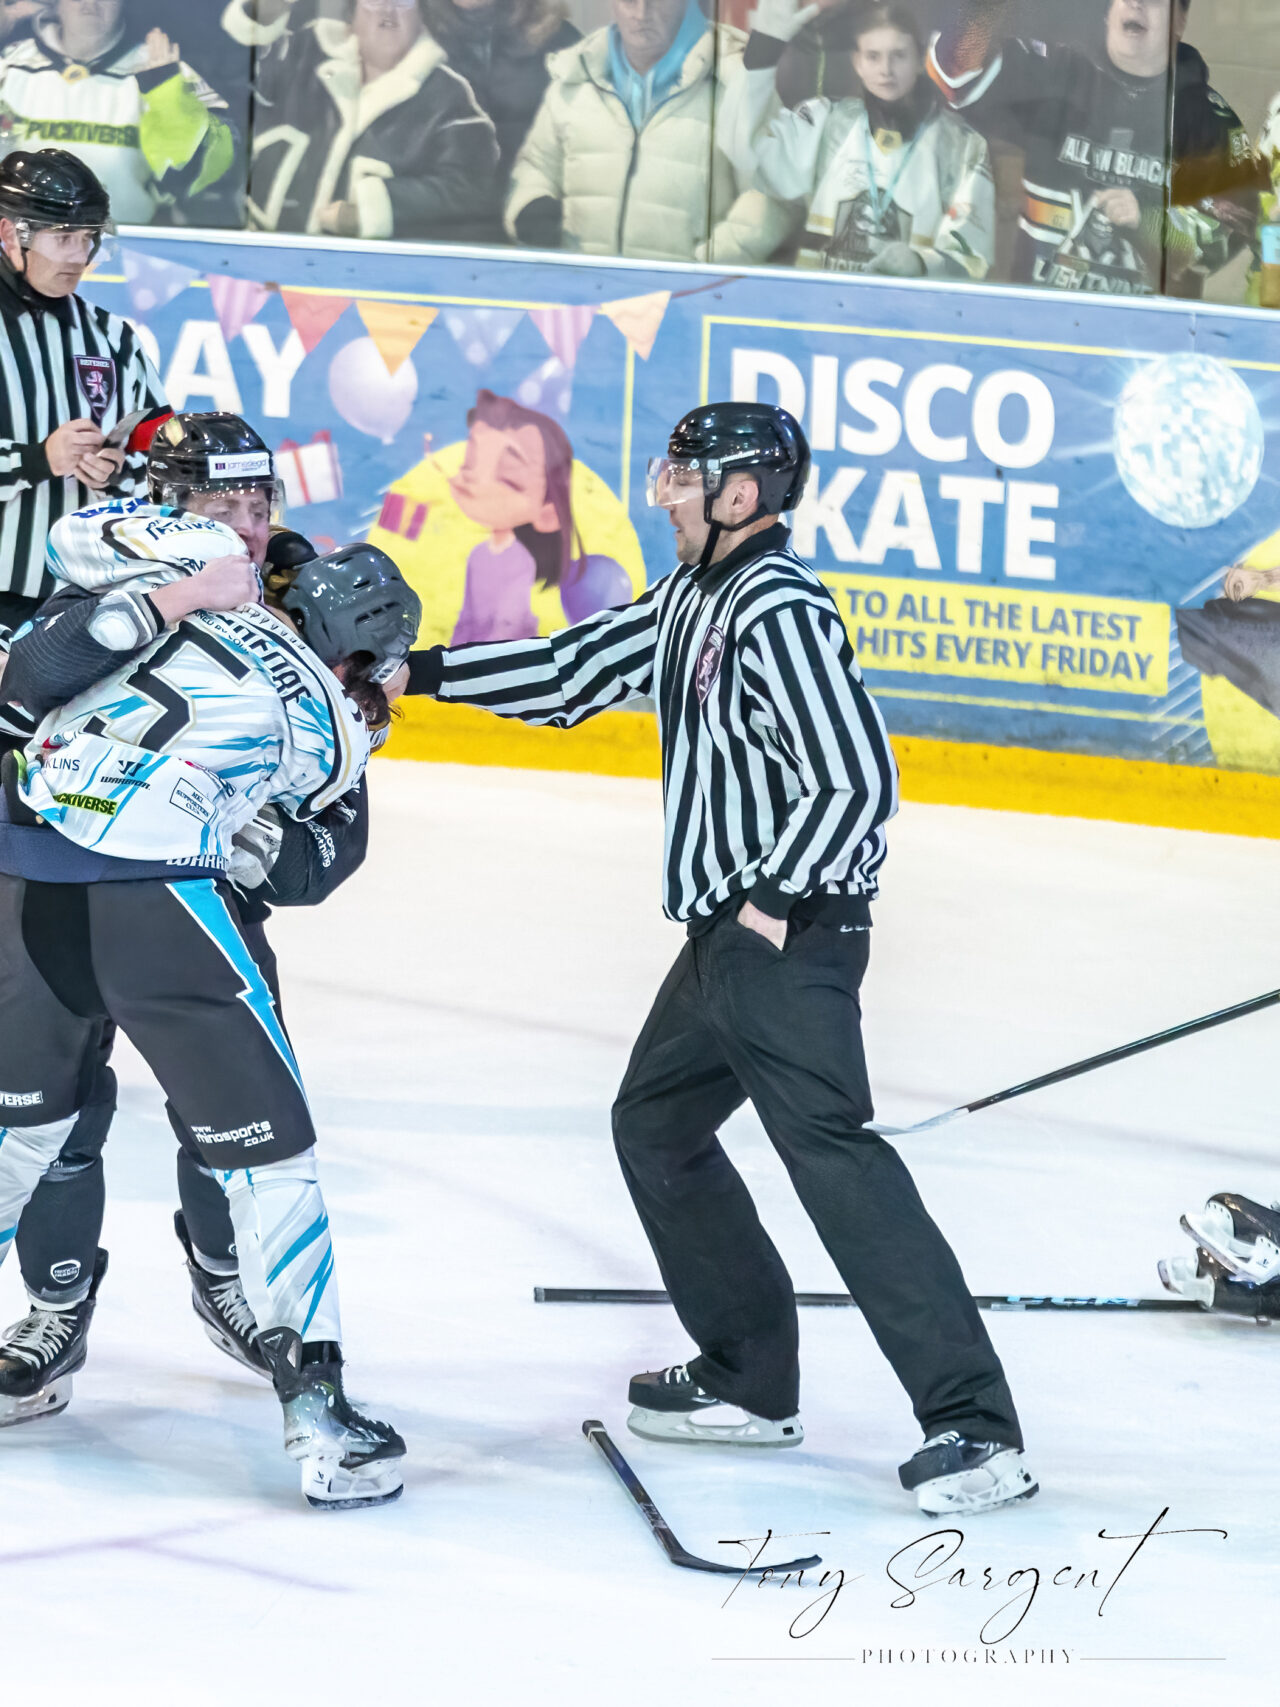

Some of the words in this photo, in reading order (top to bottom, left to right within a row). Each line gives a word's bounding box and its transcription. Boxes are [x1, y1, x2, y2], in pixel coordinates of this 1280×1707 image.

[1065, 136, 1091, 165] ALL
[730, 348, 1056, 469] DISCO
[790, 464, 1059, 581] KATE
[312, 583, 327, 598] 5
[846, 588, 889, 619] TO
[896, 593, 955, 626] ALL
[964, 598, 1022, 633] THE
[1031, 607, 1142, 644] LATEST
[856, 626, 927, 659] HITS
[936, 633, 1032, 669] EVERY
[1041, 643, 1155, 682] FRIDAY
[81, 619, 253, 753] 5
